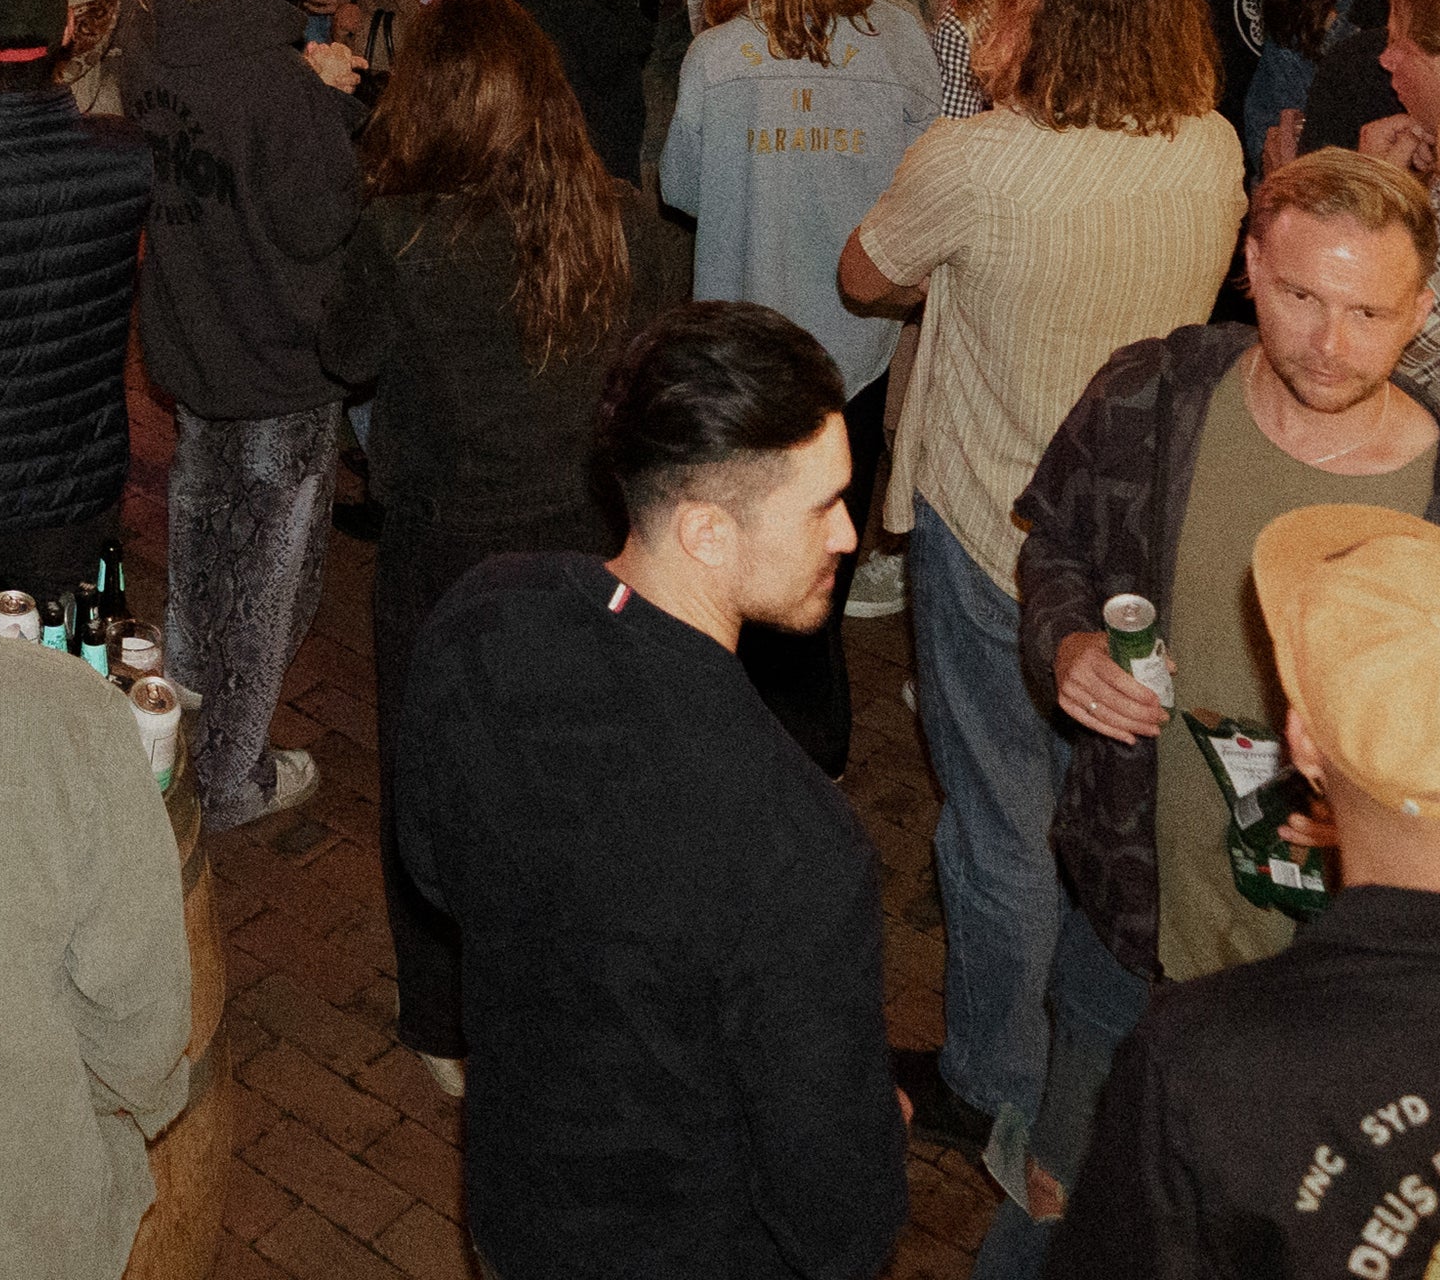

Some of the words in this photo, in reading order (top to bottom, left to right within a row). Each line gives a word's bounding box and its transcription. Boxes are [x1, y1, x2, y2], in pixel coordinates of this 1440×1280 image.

[791, 88, 813, 113] IN
[747, 127, 866, 155] PARADISE
[1296, 1144, 1346, 1213] VNC
[1360, 1094, 1430, 1146] SYD
[1347, 1174, 1438, 1279] DEUS
